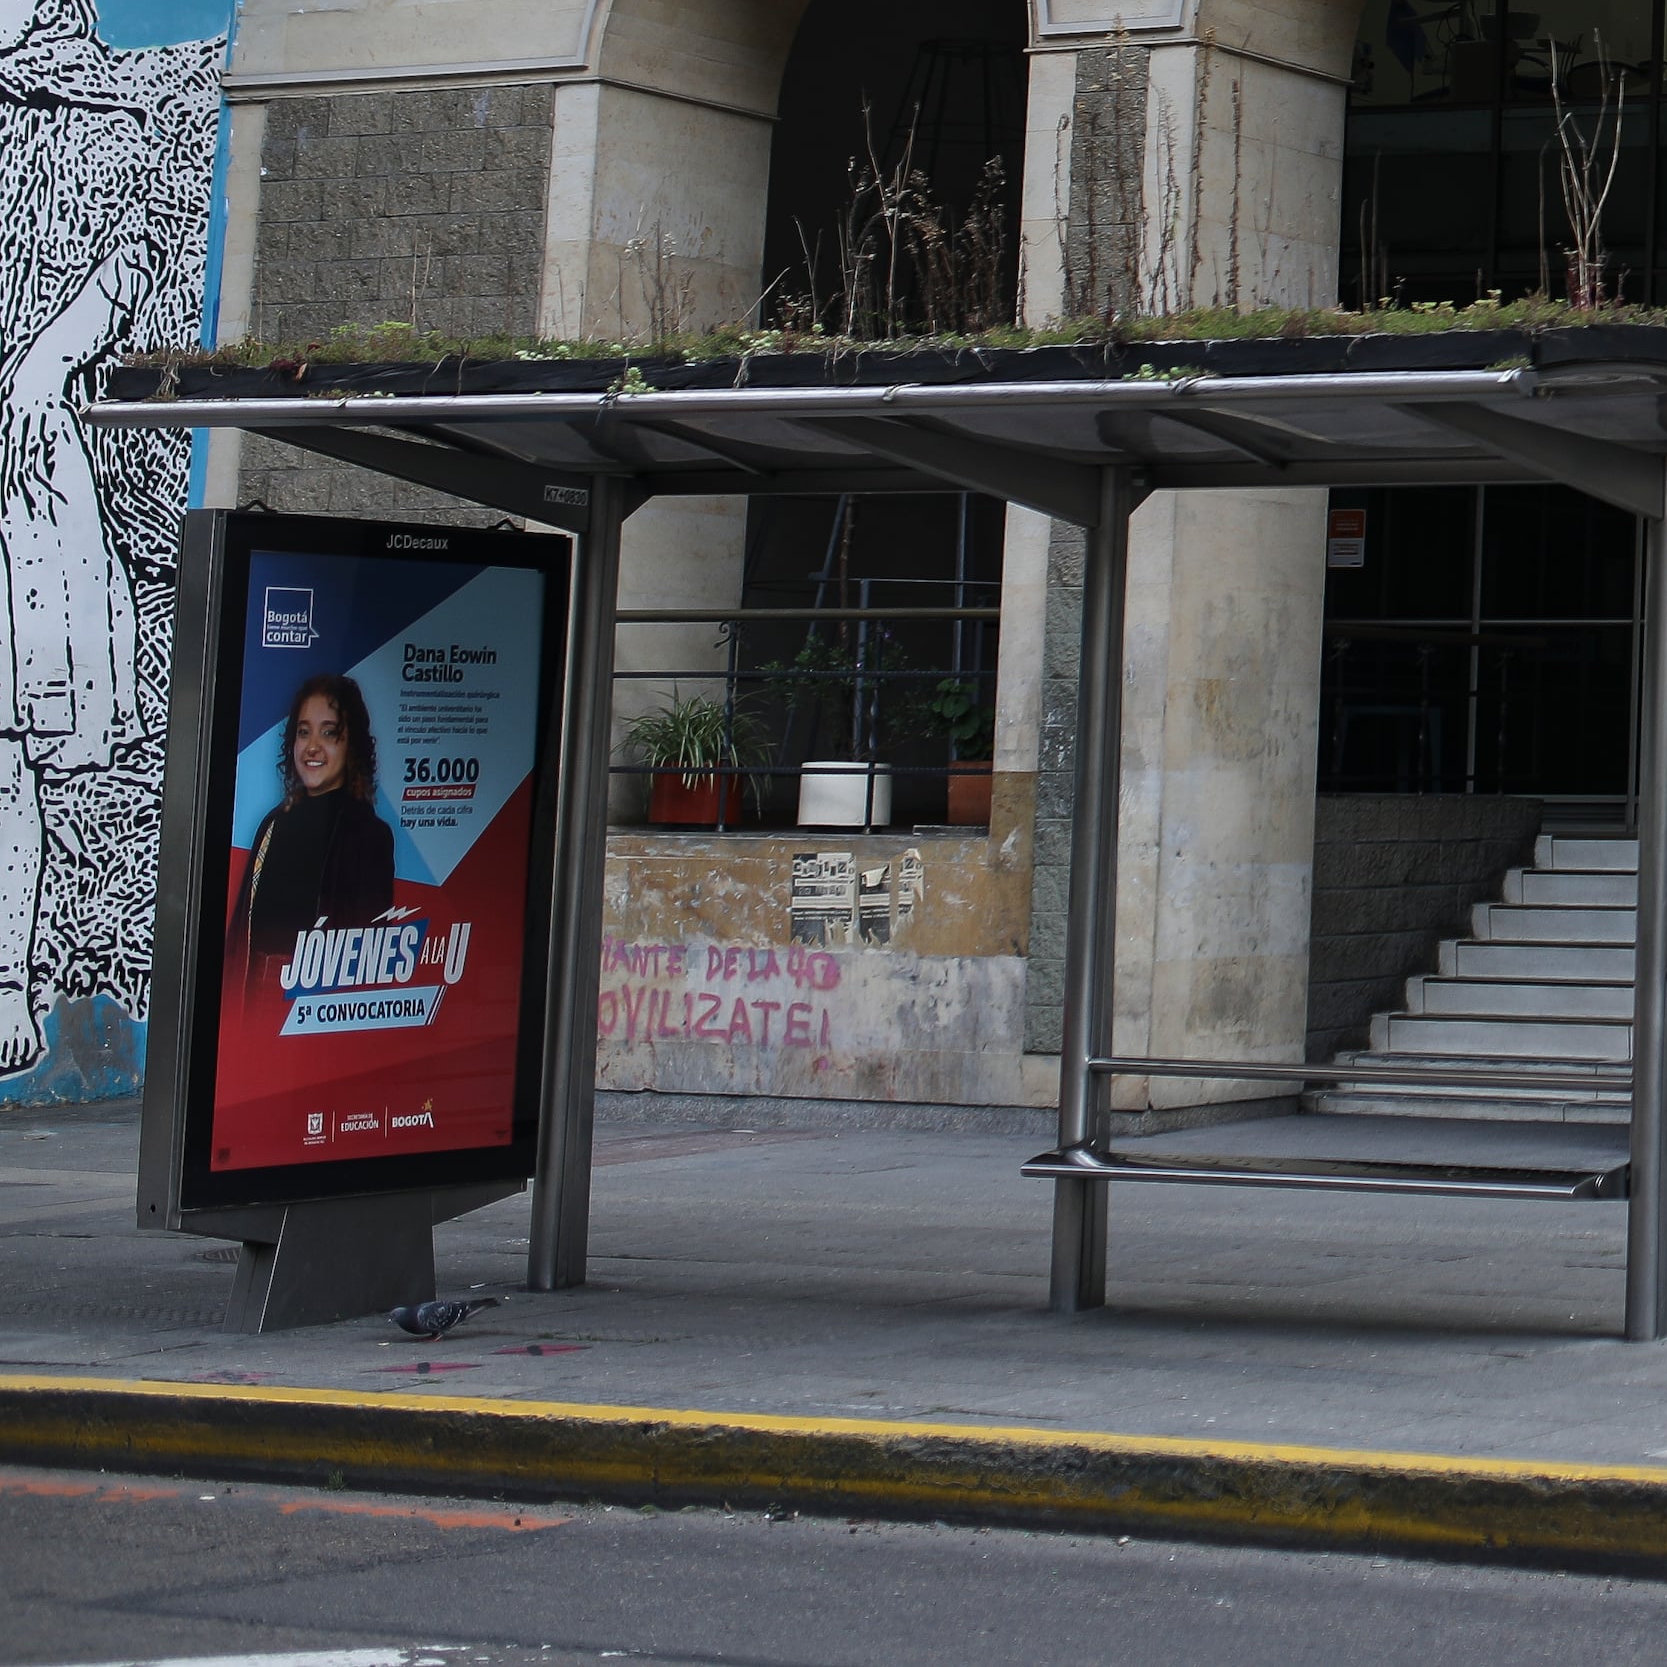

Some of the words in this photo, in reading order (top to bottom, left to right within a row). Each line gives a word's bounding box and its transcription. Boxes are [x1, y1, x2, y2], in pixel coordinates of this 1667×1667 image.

[386, 534, 448, 549] JCDecaux
[267, 610, 308, 625] Bogotá
[266, 630, 307, 643] contar
[404, 643, 445, 663] Dana
[402, 663, 464, 683] Castillo
[403, 757, 480, 783] 36.000
[406, 789, 431, 798] cupos
[432, 787, 472, 798] asignados
[400, 817, 416, 830] hay
[418, 818, 435, 827] una
[280, 916, 418, 990] JÓVENES
[420, 937, 430, 964] A
[431, 936, 445, 964] LA
[444, 922, 472, 985] U
[706, 945, 742, 982] DE
[747, 947, 780, 982] LA
[317, 998, 425, 1023] CONVOCATORIA
[341, 1119, 379, 1132] EDUCACIÓN
